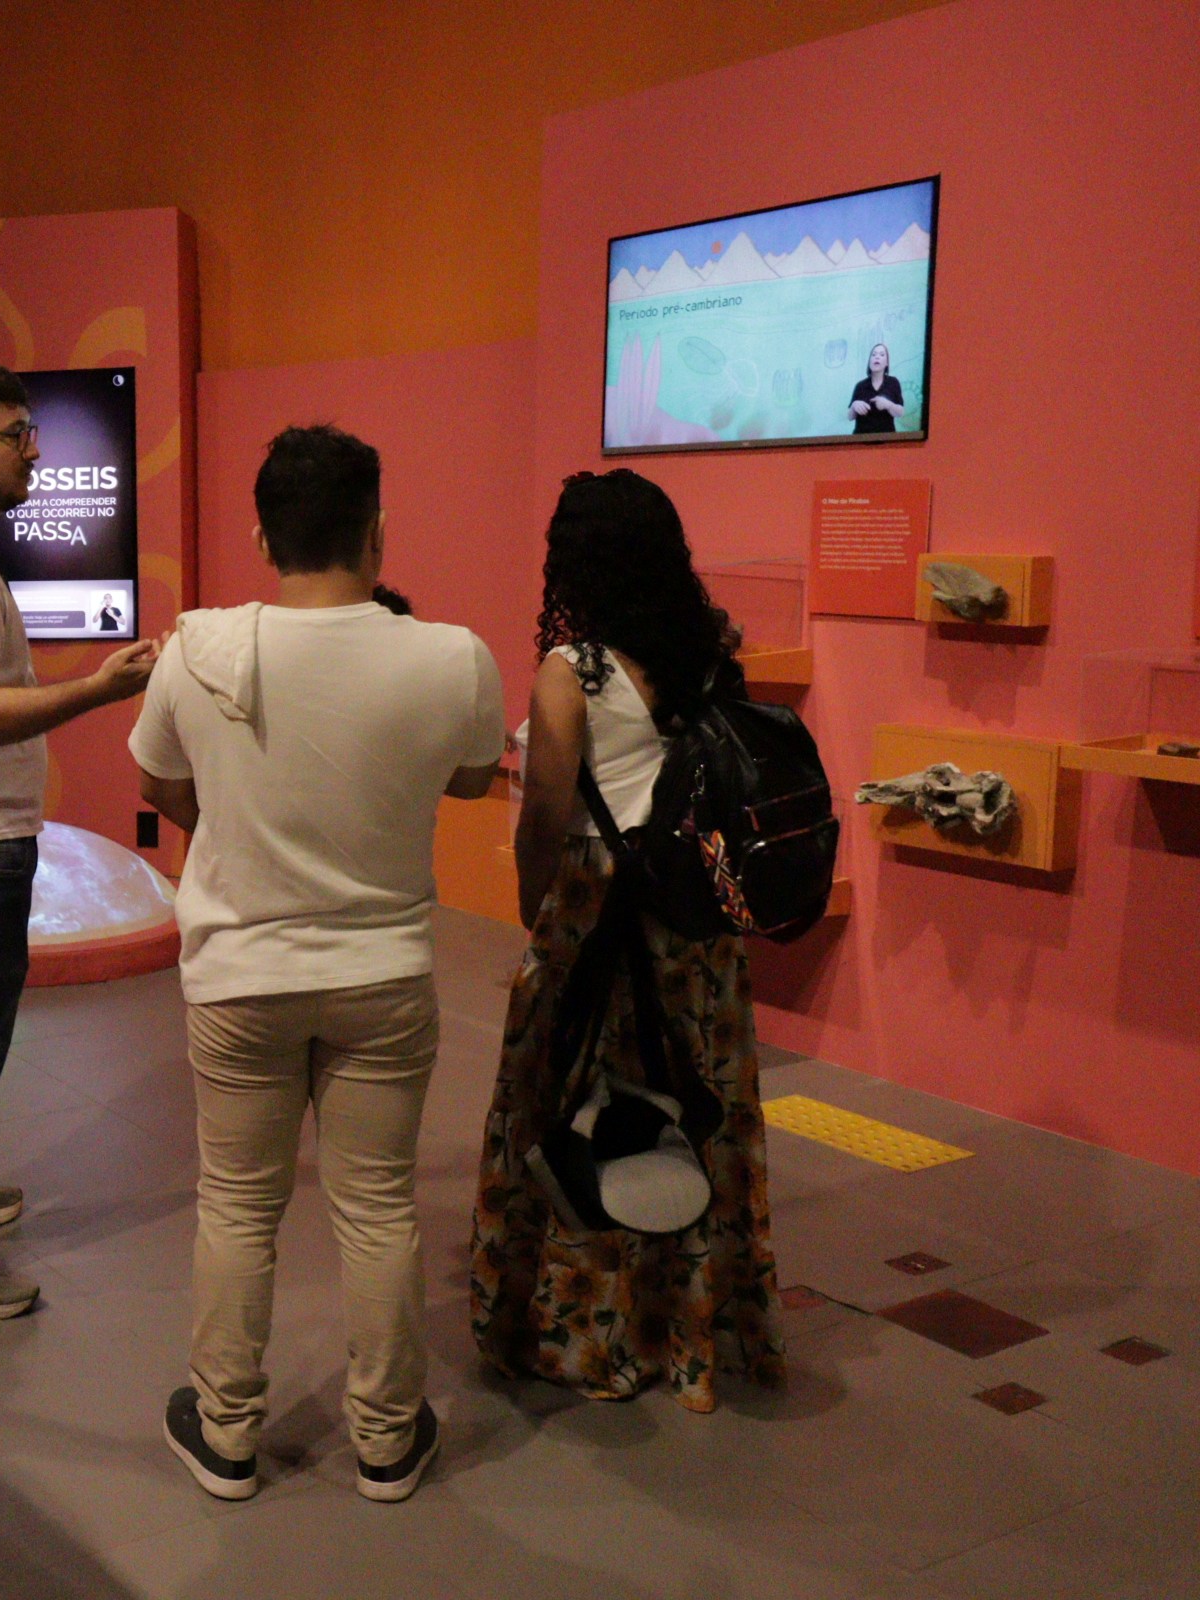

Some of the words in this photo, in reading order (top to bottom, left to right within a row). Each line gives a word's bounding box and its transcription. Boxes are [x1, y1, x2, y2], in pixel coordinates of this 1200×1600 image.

[26, 466, 118, 492] OSSEIS
[41, 499, 49, 507] A
[49, 497, 117, 507] COMPREENDER
[6, 509, 16, 519] O
[17, 509, 40, 519] QUE
[42, 508, 96, 518] OCORREU
[97, 507, 115, 517] NO
